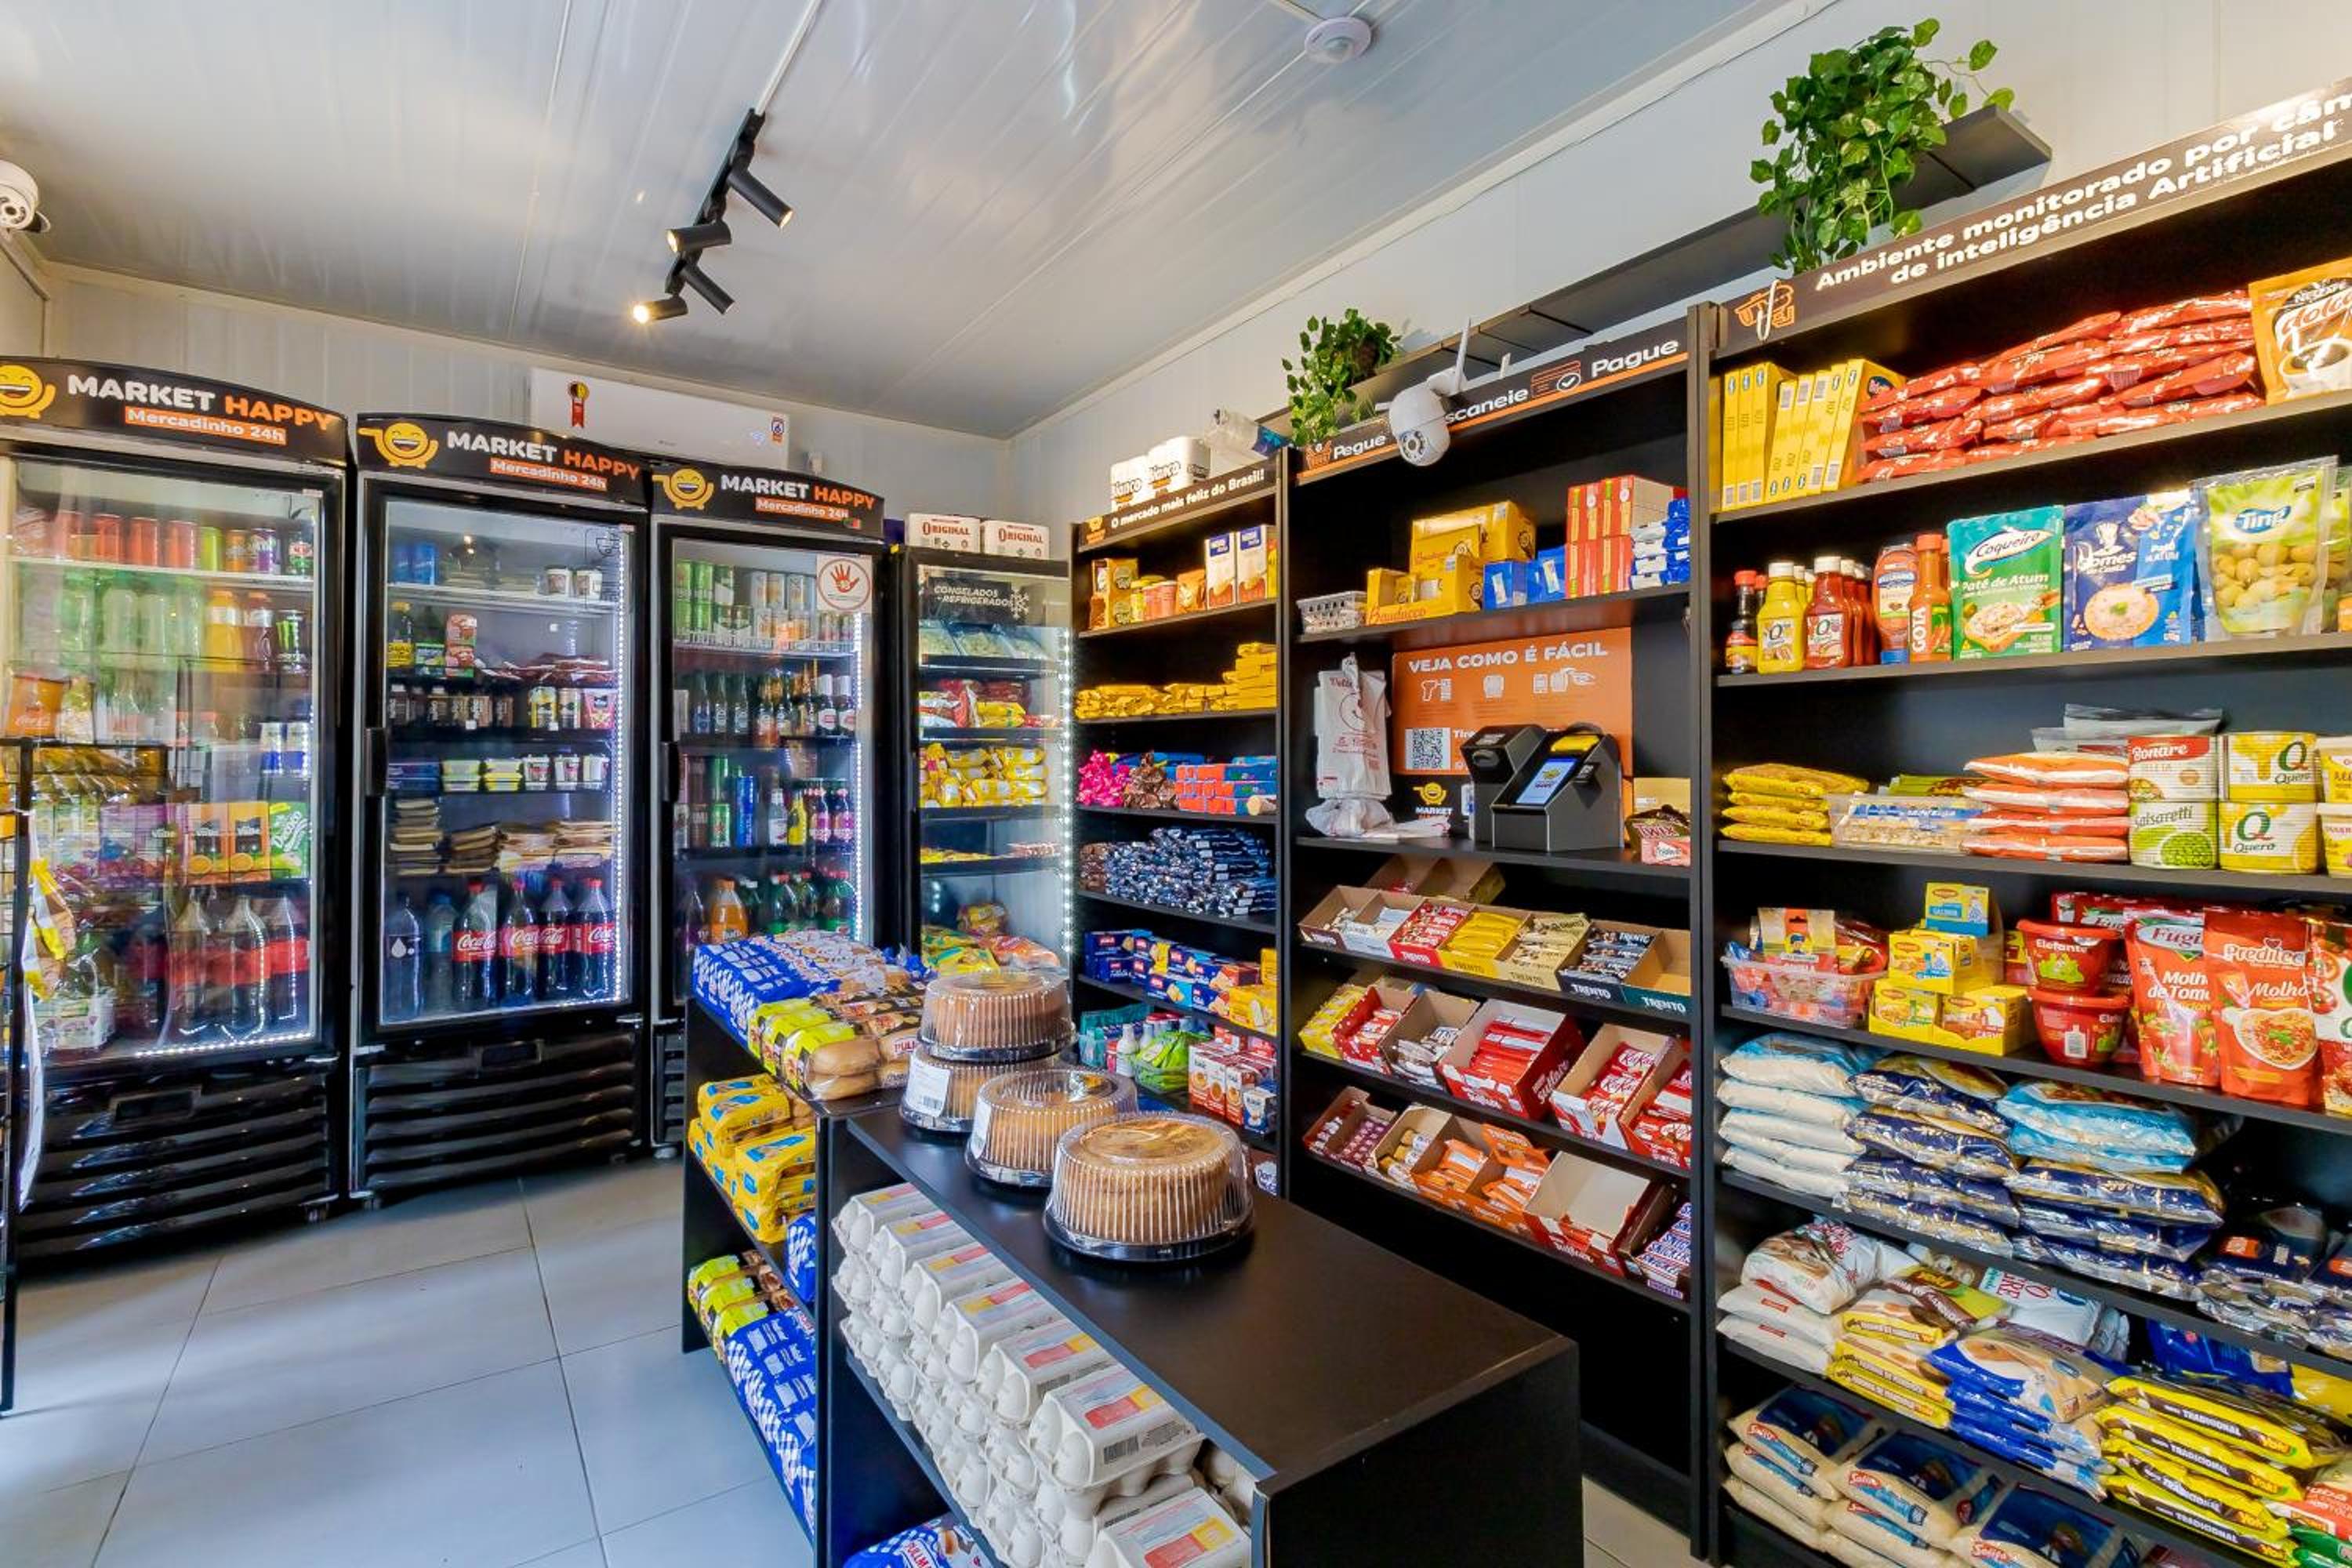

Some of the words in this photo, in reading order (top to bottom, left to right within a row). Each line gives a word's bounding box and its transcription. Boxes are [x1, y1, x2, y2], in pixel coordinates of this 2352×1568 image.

[1816, 231, 1954, 289] Ambiente
[1963, 157, 2171, 241] monitorado
[2184, 126, 2258, 167] por
[1890, 259, 1929, 285] de
[1937, 191, 2136, 270] inteligência
[2148, 120, 2335, 200] Artificial
[67, 374, 216, 412] MARKET
[224, 395, 337, 430] HAPPY
[1333, 432, 1386, 459] Pegue
[1446, 389, 1529, 423] scaneie
[1590, 340, 1679, 379] Pague
[127, 408, 244, 437] Mercadinho
[249, 424, 285, 443] 24h
[446, 431, 557, 462] MARKET
[563, 449, 640, 480] HAPPY
[492, 459, 579, 484] Mercadinho
[580, 475, 607, 489] 24h
[720, 474, 809, 499] MARKET
[813, 485, 876, 509] HAPPY
[757, 498, 826, 517] Mercadinho
[1111, 515, 1120, 528] O
[1120, 502, 1160, 526] mercado
[1161, 493, 1184, 512] mais
[1186, 488, 1210, 505] feliz
[1211, 483, 1226, 496] do
[1229, 469, 1265, 491] Brasil!
[1976, 532, 2041, 559] Coqueiro
[1991, 578, 2007, 586] de
[2009, 573, 2049, 585] Atum
[1913, 607, 1926, 652] GOTA
[1409, 659, 1452, 673] VEJA
[1457, 650, 1518, 668] COMO
[1525, 645, 1537, 662] É
[1544, 641, 1608, 660] FÁCIL
[2132, 744, 2188, 761] Bonare
[2278, 740, 2309, 772] Q
[2237, 811, 2273, 841] Q
[2234, 841, 2275, 853] Quero
[2036, 939, 2088, 953] Elefante
[2147, 987, 2165, 998] de
[2249, 982, 2311, 998] Molho
